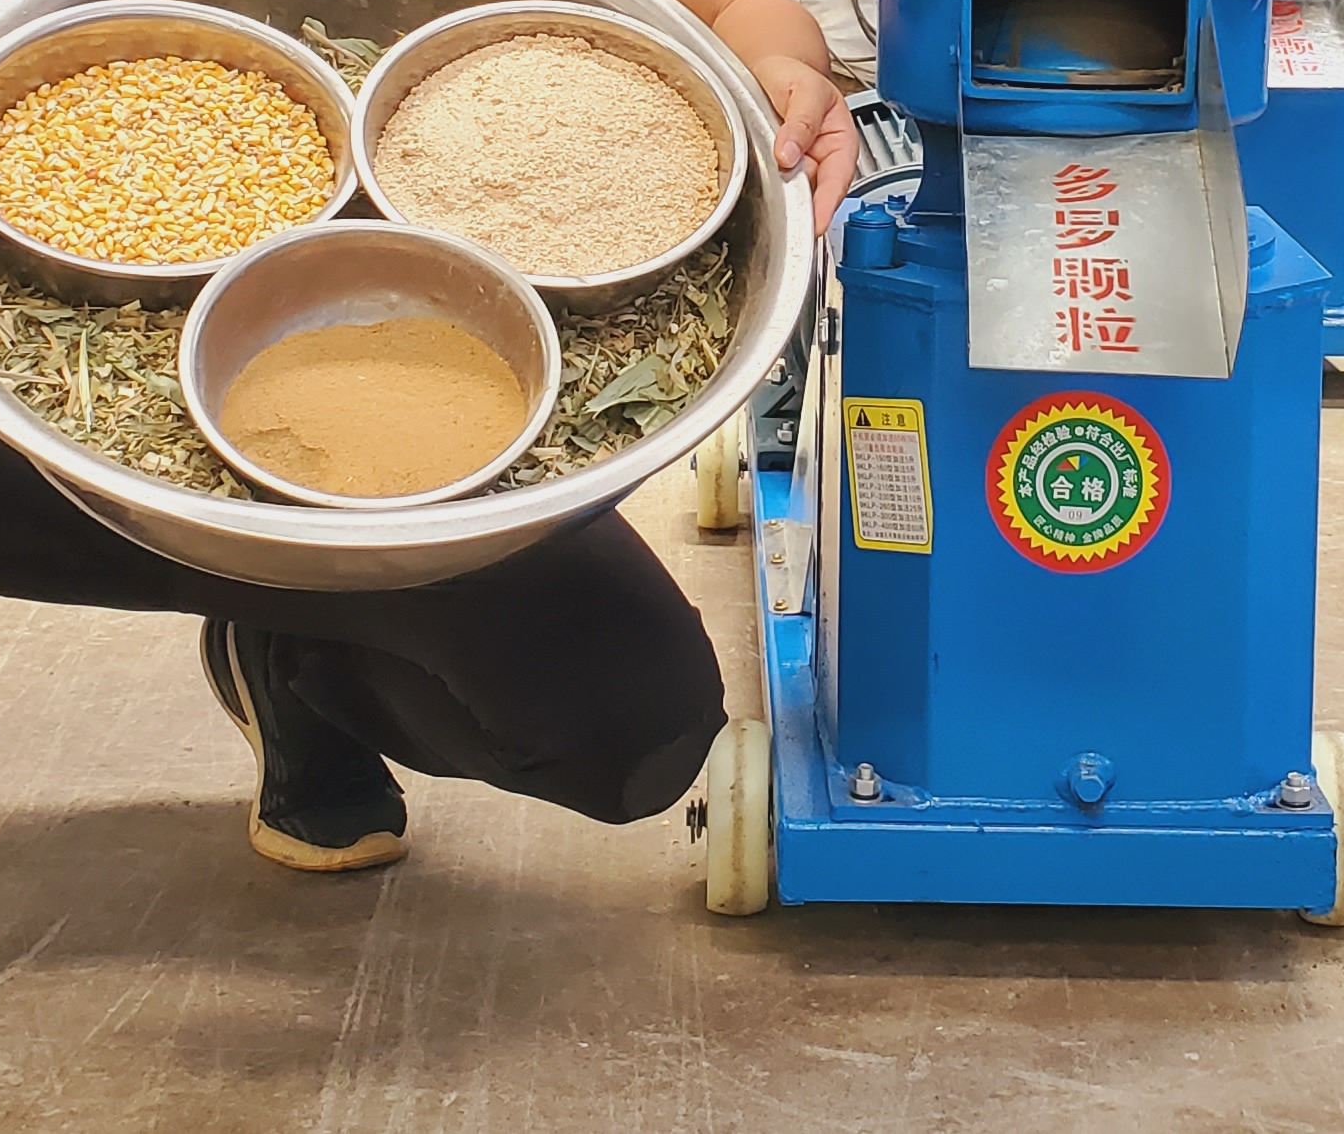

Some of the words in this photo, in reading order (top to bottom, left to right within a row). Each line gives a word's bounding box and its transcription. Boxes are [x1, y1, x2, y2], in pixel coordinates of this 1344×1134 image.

[1052, 164, 1142, 353] 多罗颗粒
[1050, 475, 1106, 503] 合格
